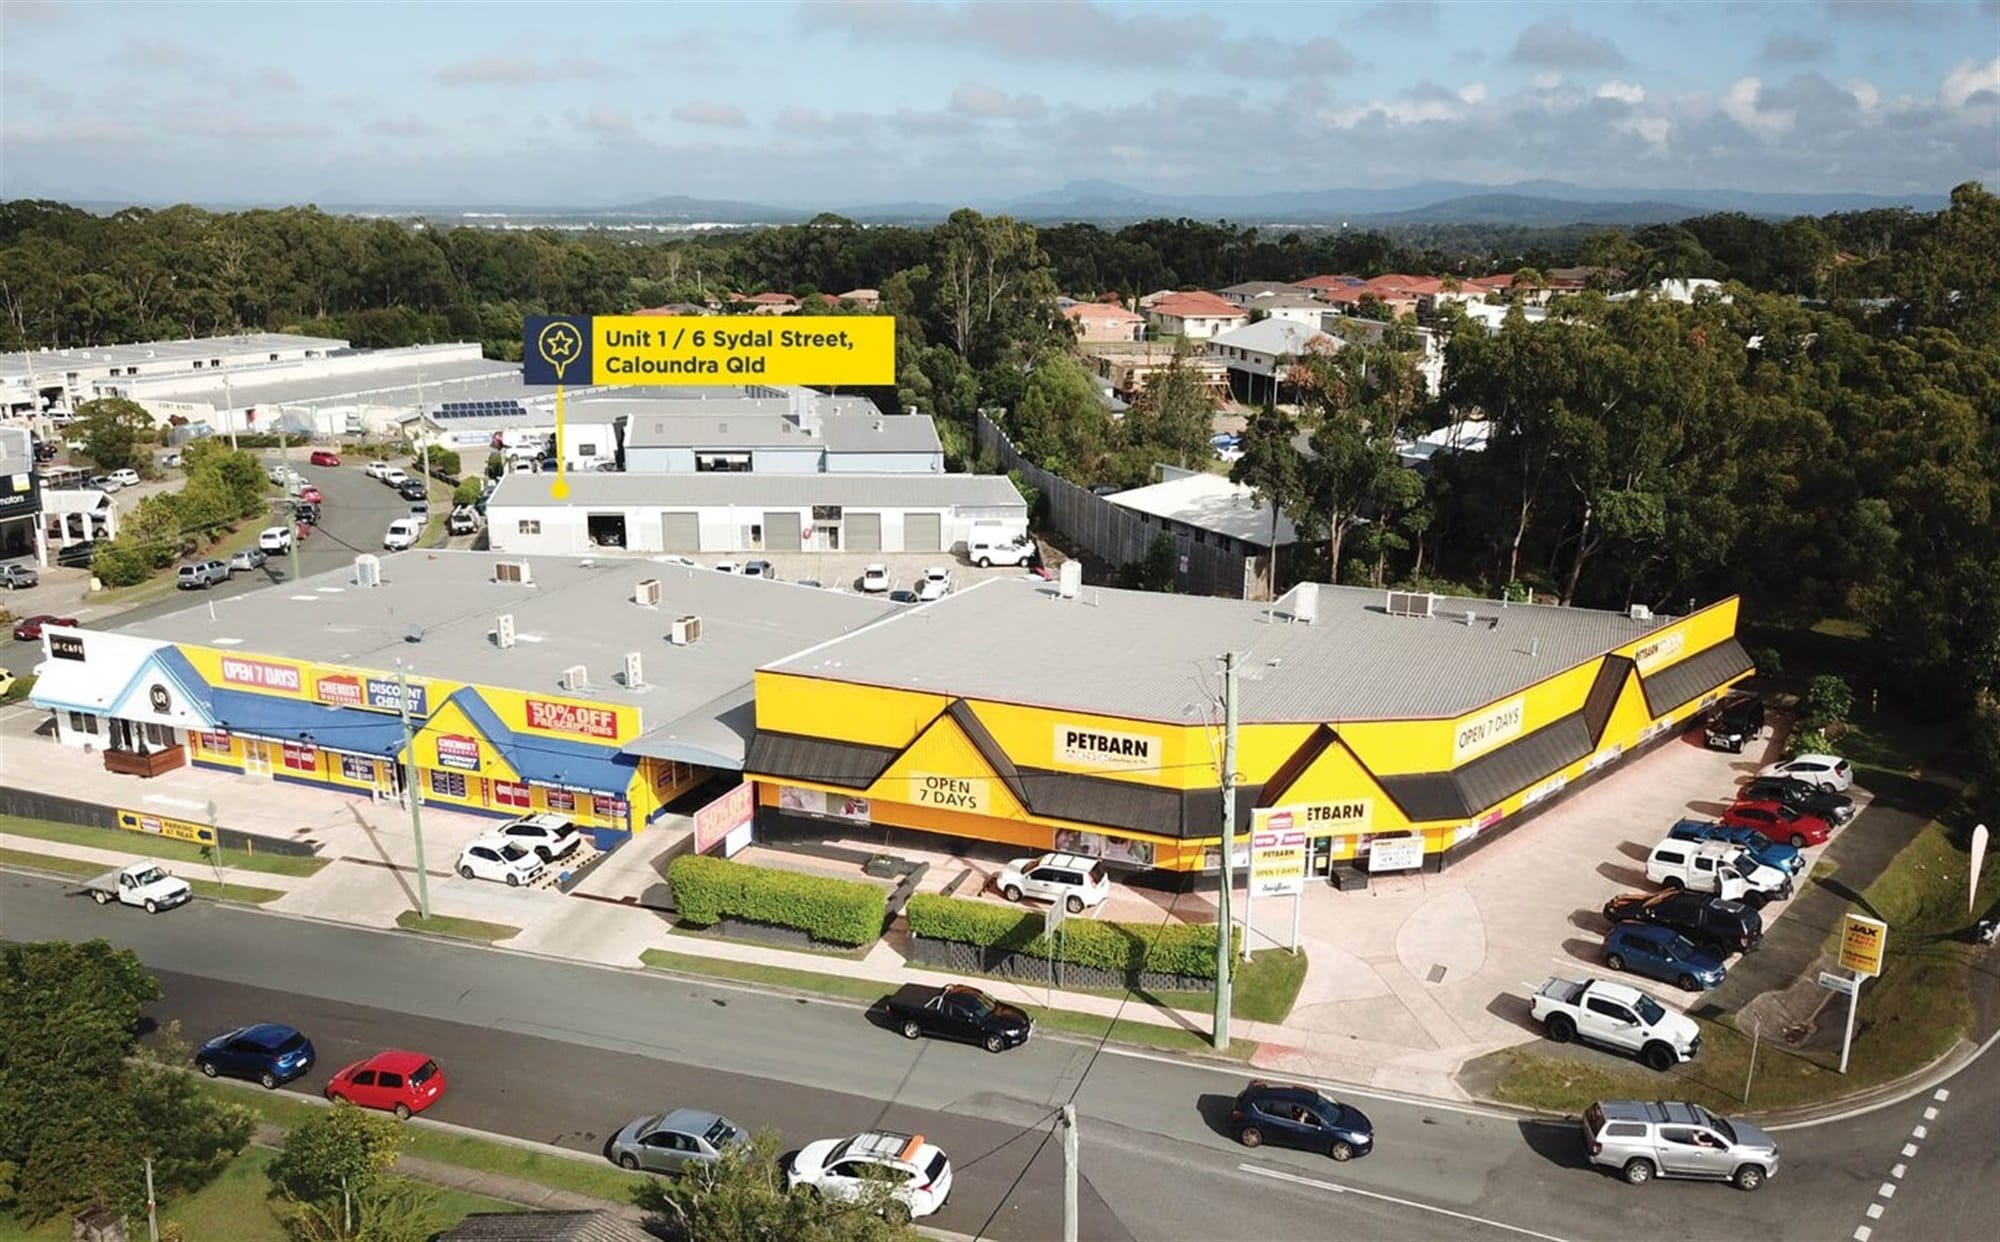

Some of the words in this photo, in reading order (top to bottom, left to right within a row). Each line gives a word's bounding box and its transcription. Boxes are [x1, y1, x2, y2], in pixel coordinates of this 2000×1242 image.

[224, 660, 253, 682] OPEN
[254, 663, 263, 683] 7
[369, 682, 422, 699] DISCONT
[375, 695, 419, 711] CHEMST
[531, 702, 575, 722] 50%
[576, 708, 612, 727] OFF
[1459, 722, 1485, 748] OPEN
[1495, 707, 1519, 732] DAYS
[1066, 731, 1148, 757] PETBARN
[926, 776, 970, 794] OPEN
[920, 788, 928, 801] 7
[934, 791, 977, 809] DAYS
[1307, 803, 1364, 821] ETBARN
[1849, 924, 1878, 937] JAX
